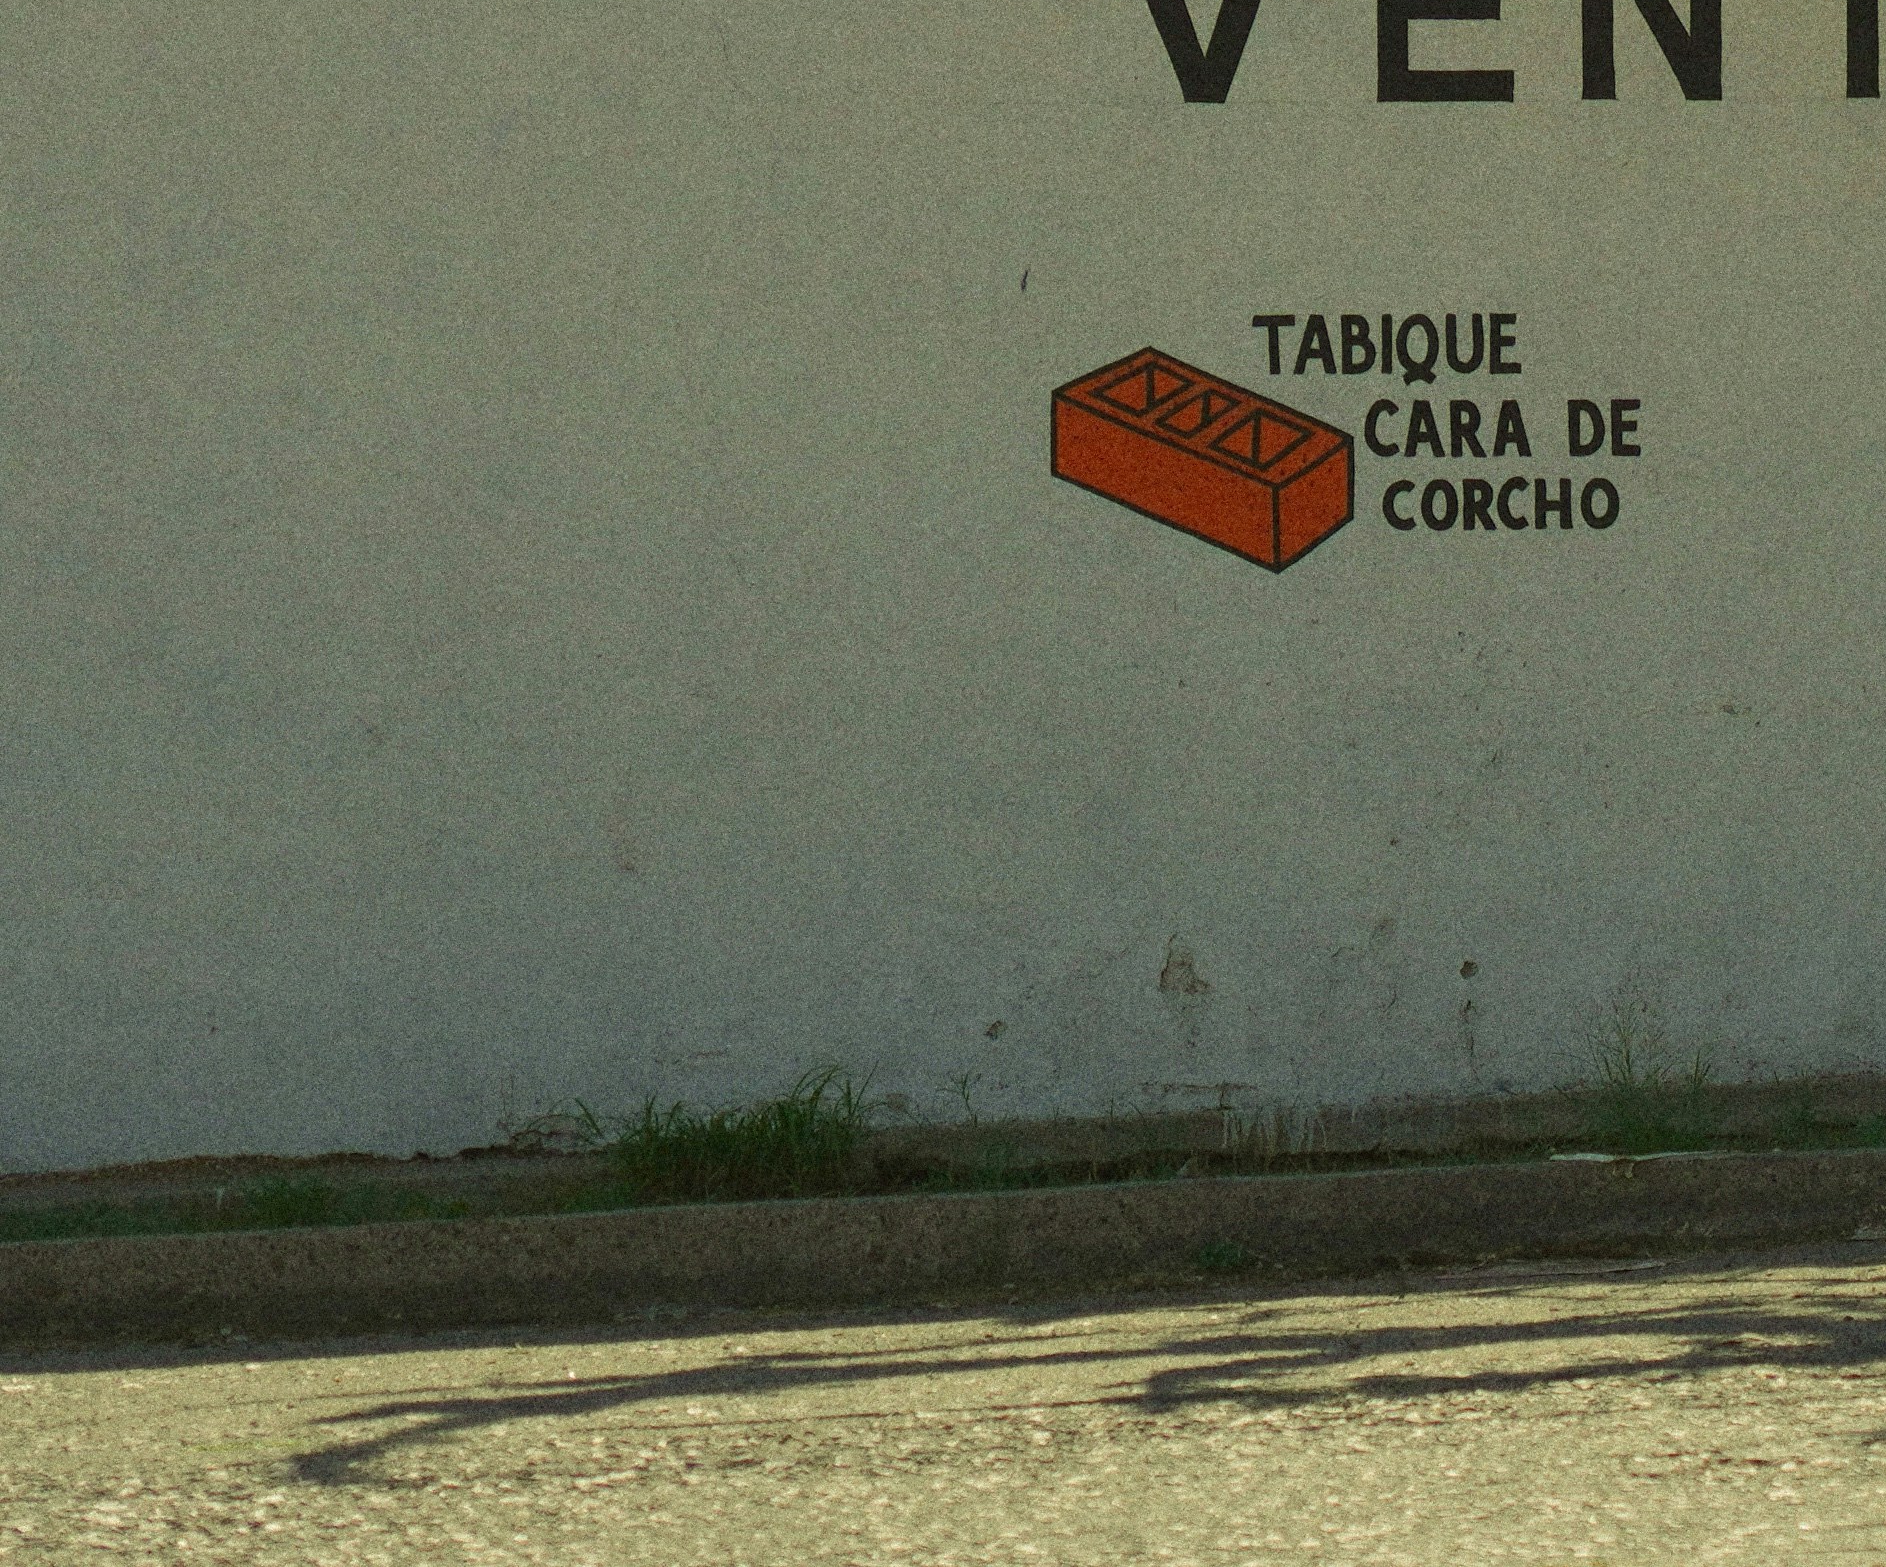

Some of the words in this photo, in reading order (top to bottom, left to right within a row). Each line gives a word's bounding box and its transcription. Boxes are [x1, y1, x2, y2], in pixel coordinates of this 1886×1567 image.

[1252, 313, 1522, 385] TABIQUE
[1364, 399, 1531, 457] CARA
[1567, 399, 1641, 456] DE
[1382, 477, 1620, 530] CORCHO
